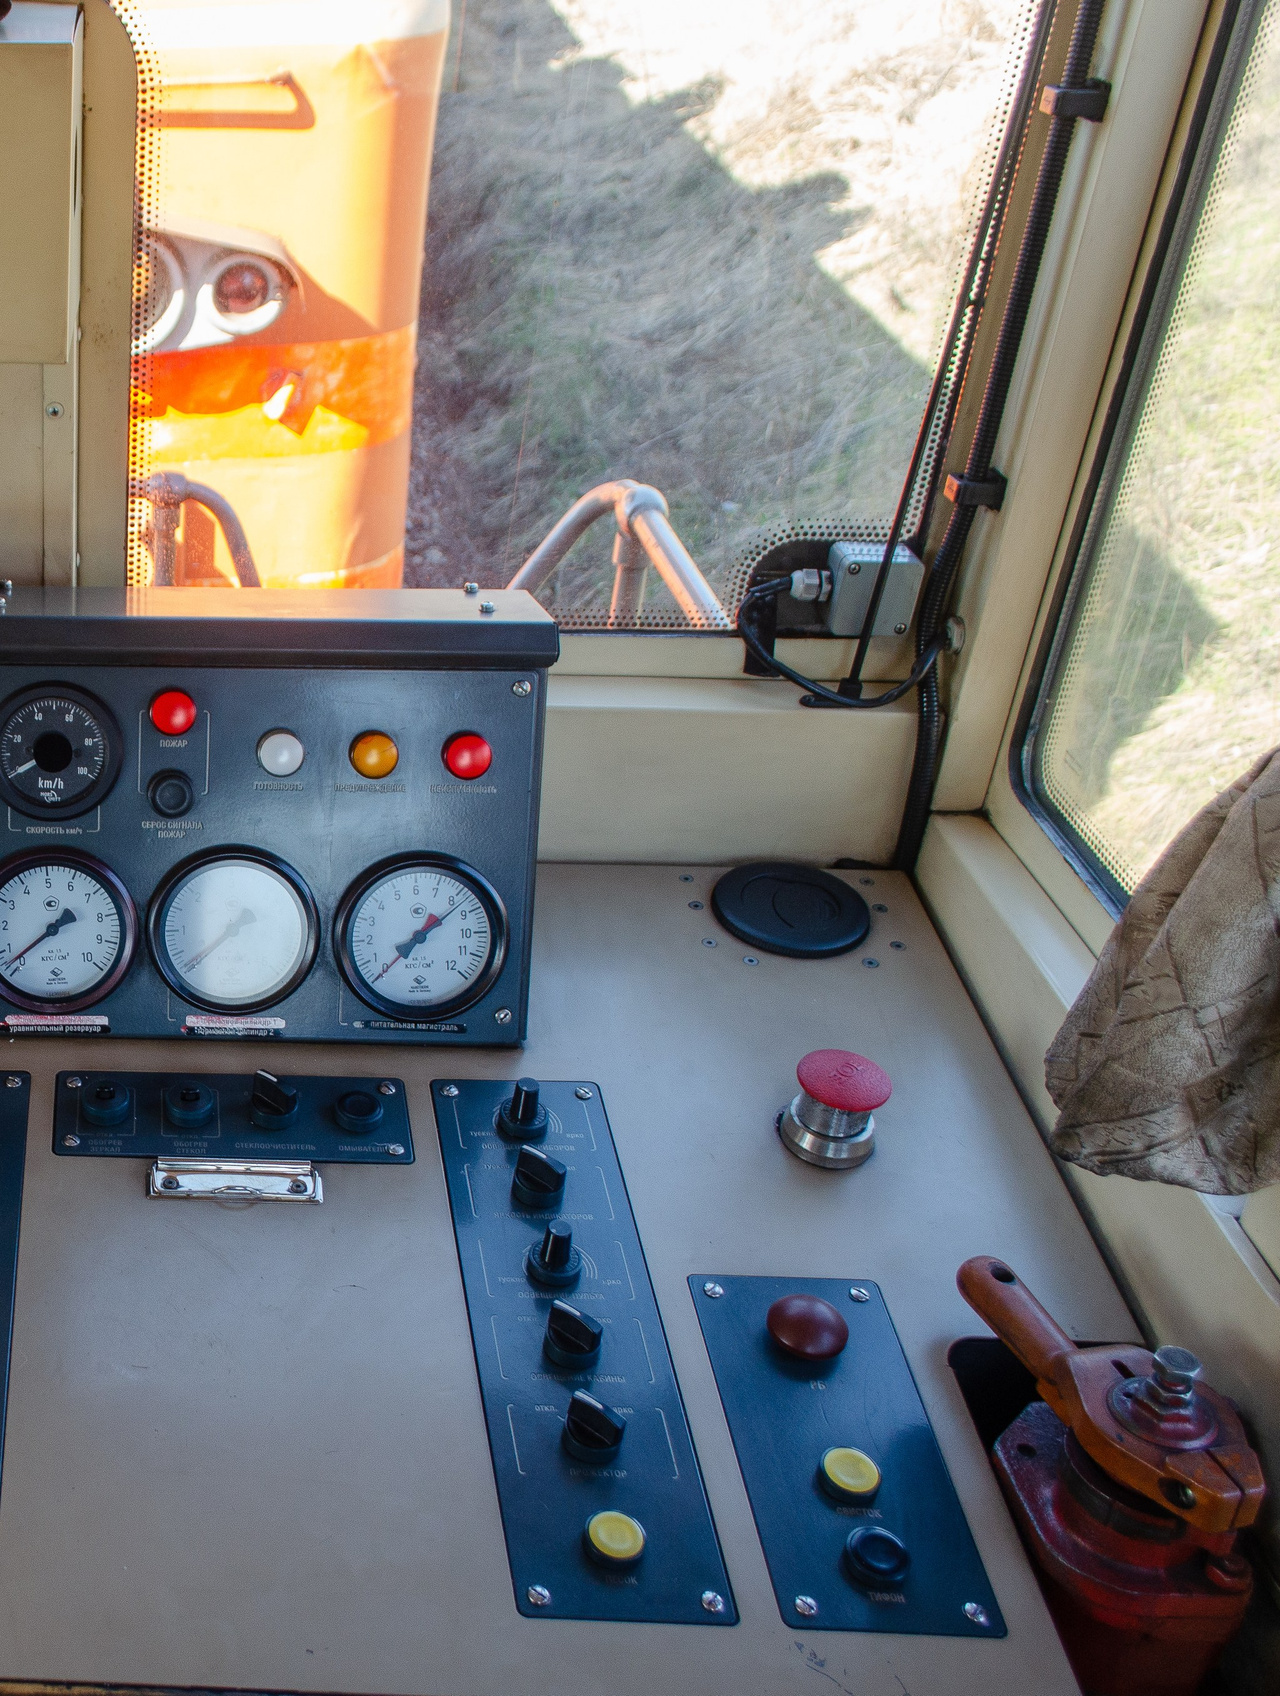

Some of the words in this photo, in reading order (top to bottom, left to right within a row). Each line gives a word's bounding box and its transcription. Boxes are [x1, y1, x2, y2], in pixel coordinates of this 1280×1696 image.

[33, 712, 43, 721] 40
[64, 713, 74, 722] 60
[13, 734, 22, 743] 20
[83, 737, 93, 747] 80
[159, 739, 188, 748] ПОЖАР
[77, 766, 88, 775] 100
[38, 776, 64, 789] km/h
[253, 782, 303, 791] ГОТОВНОСТЬ
[334, 783, 406, 793] ПРЕДУПРЕЖДЕНИЕ
[26, 826, 65, 834] СКОРОСТЬ
[66, 826, 83, 835] км/ч
[141, 821, 166, 829] СБРОС
[167, 821, 203, 830] СИГНАЛА
[158, 830, 186, 838] ПОЖАР
[45, 878, 52, 889] 5
[67, 881, 74, 892] 6
[23, 885, 31, 896] 4
[394, 890, 401, 901] 5
[412, 885, 420, 896] 6
[432, 887, 439, 898] 7
[84, 893, 92, 904] 7
[448, 895, 456, 906] 8
[8, 900, 16, 911] 3
[378, 900, 385, 911] 4
[96, 912, 104, 923] 8
[460, 909, 467, 921] 9
[2, 920, 9, 931] 2
[368, 916, 376, 927] 3
[182, 925, 186, 935] 1
[460, 928, 472, 939] 10
[95, 934, 103, 945] 9
[366, 934, 373, 945] 2
[7, 943, 12, 953] 1
[458, 945, 467, 955] 11
[19, 956, 26, 967] 0
[81, 952, 93, 962] 10
[373, 953, 378, 962] 1
[382, 962, 389, 973] 0
[445, 960, 457, 971] 12
[9, 1024, 64, 1033] уравнительный
[65, 1025, 101, 1033] резервуар
[370, 1021, 415, 1029] питательная
[417, 1022, 458, 1031] магистраль
[269, 1028, 274, 1036] 2
[88, 1138, 123, 1147] ОБОГРЕВ
[173, 1140, 208, 1148] ОБОГРЕВ
[234, 1141, 316, 1152] СТЕКЛООЧИСТИТЕЛЬ
[338, 1145, 386, 1153] ОМЫВАТЕЛ
[586, 1373, 626, 1383] КАБИНЫ
[569, 1468, 627, 1478] ПРОЖЕКТОР
[835, 1505, 883, 1519] СВИСТОК
[604, 1574, 638, 1586] ПЕСОК
[867, 1590, 906, 1605] ТИФОН
